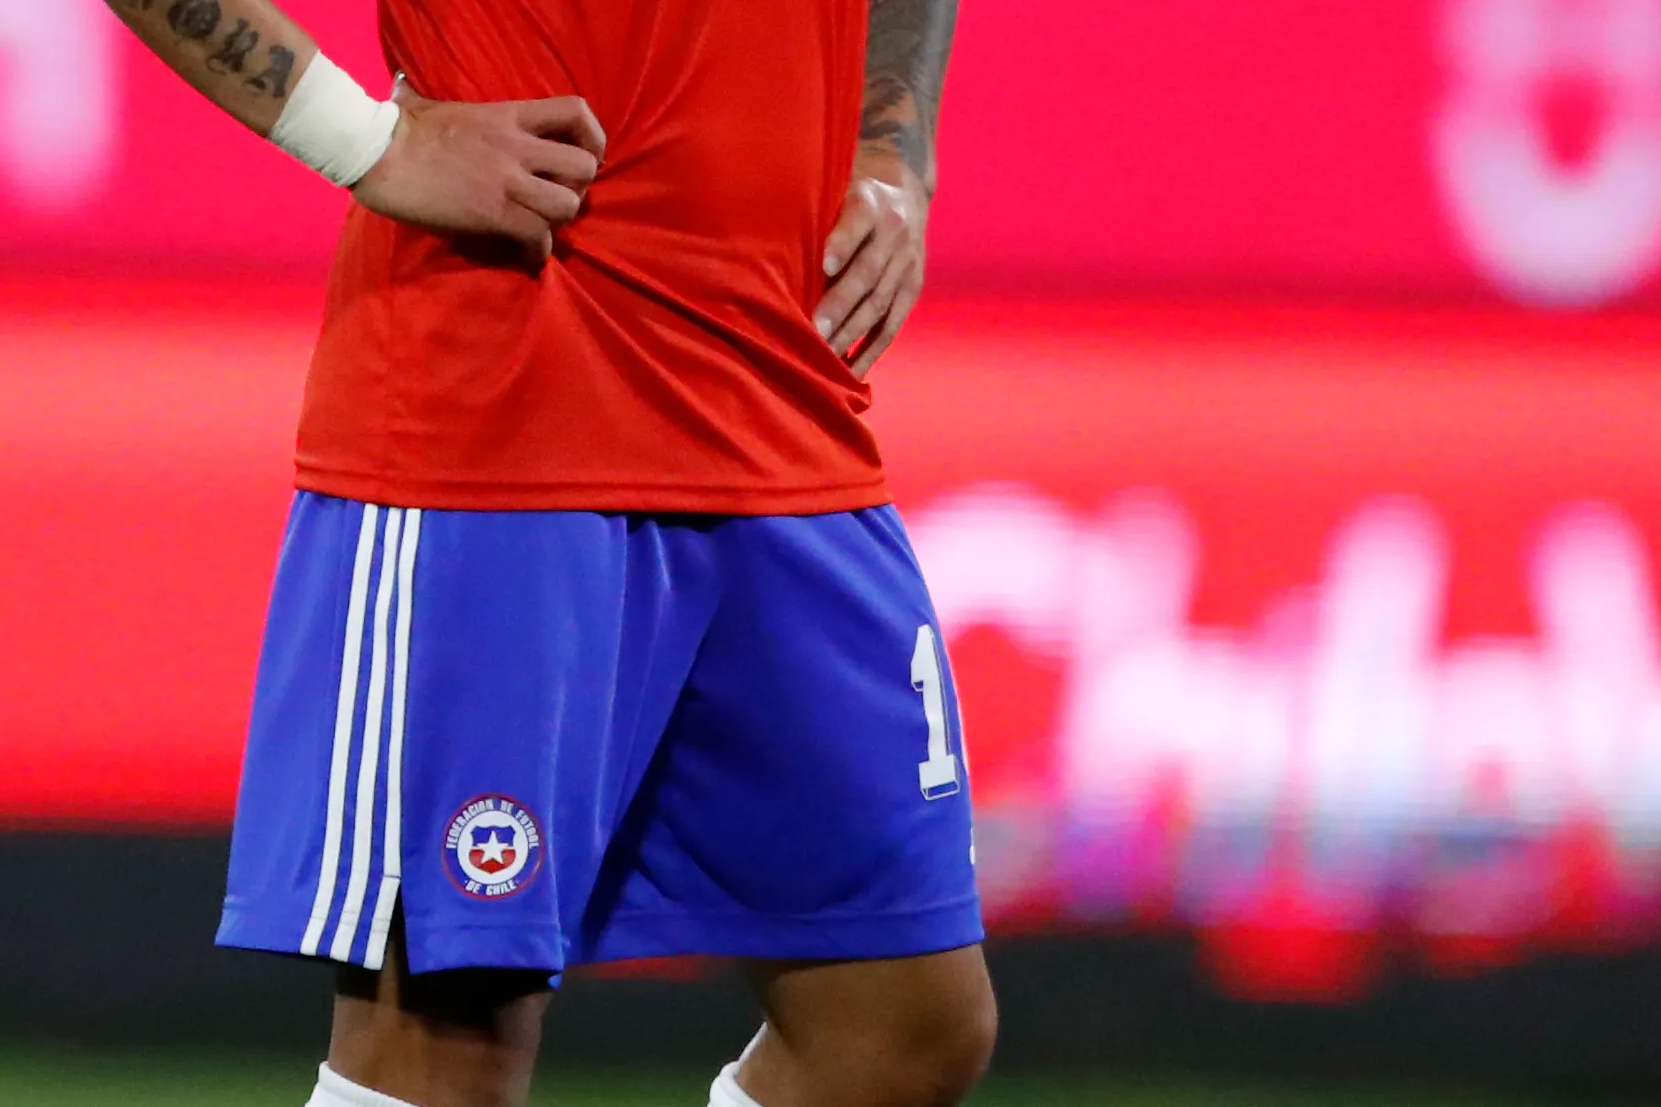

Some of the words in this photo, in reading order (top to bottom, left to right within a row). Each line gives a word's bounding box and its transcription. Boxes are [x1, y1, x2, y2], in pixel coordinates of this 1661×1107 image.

[910, 623, 960, 801] 1
[465, 879, 481, 893] DE
[486, 879, 517, 896] CHILE
